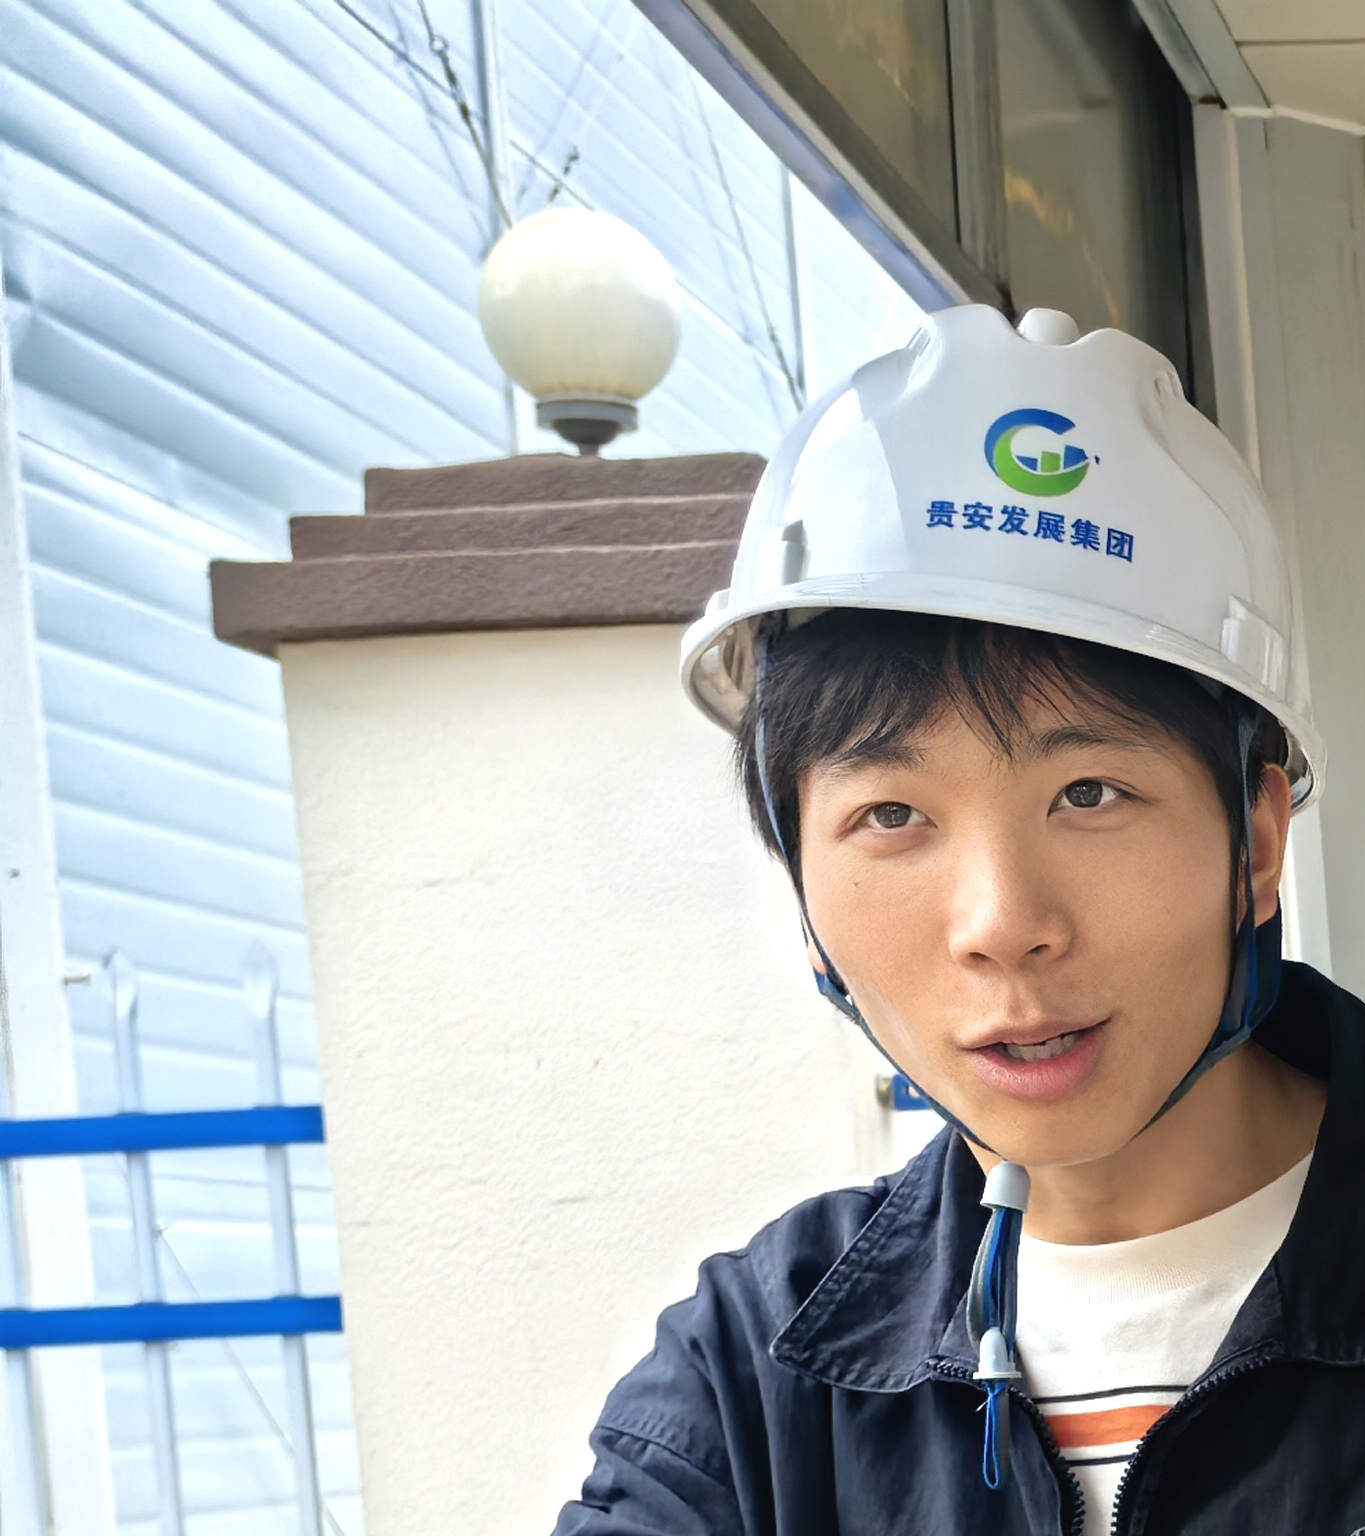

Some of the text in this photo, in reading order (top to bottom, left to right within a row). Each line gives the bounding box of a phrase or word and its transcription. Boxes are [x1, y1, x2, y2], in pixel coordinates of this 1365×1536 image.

[926, 500, 1134, 563] 贵安发展集团
